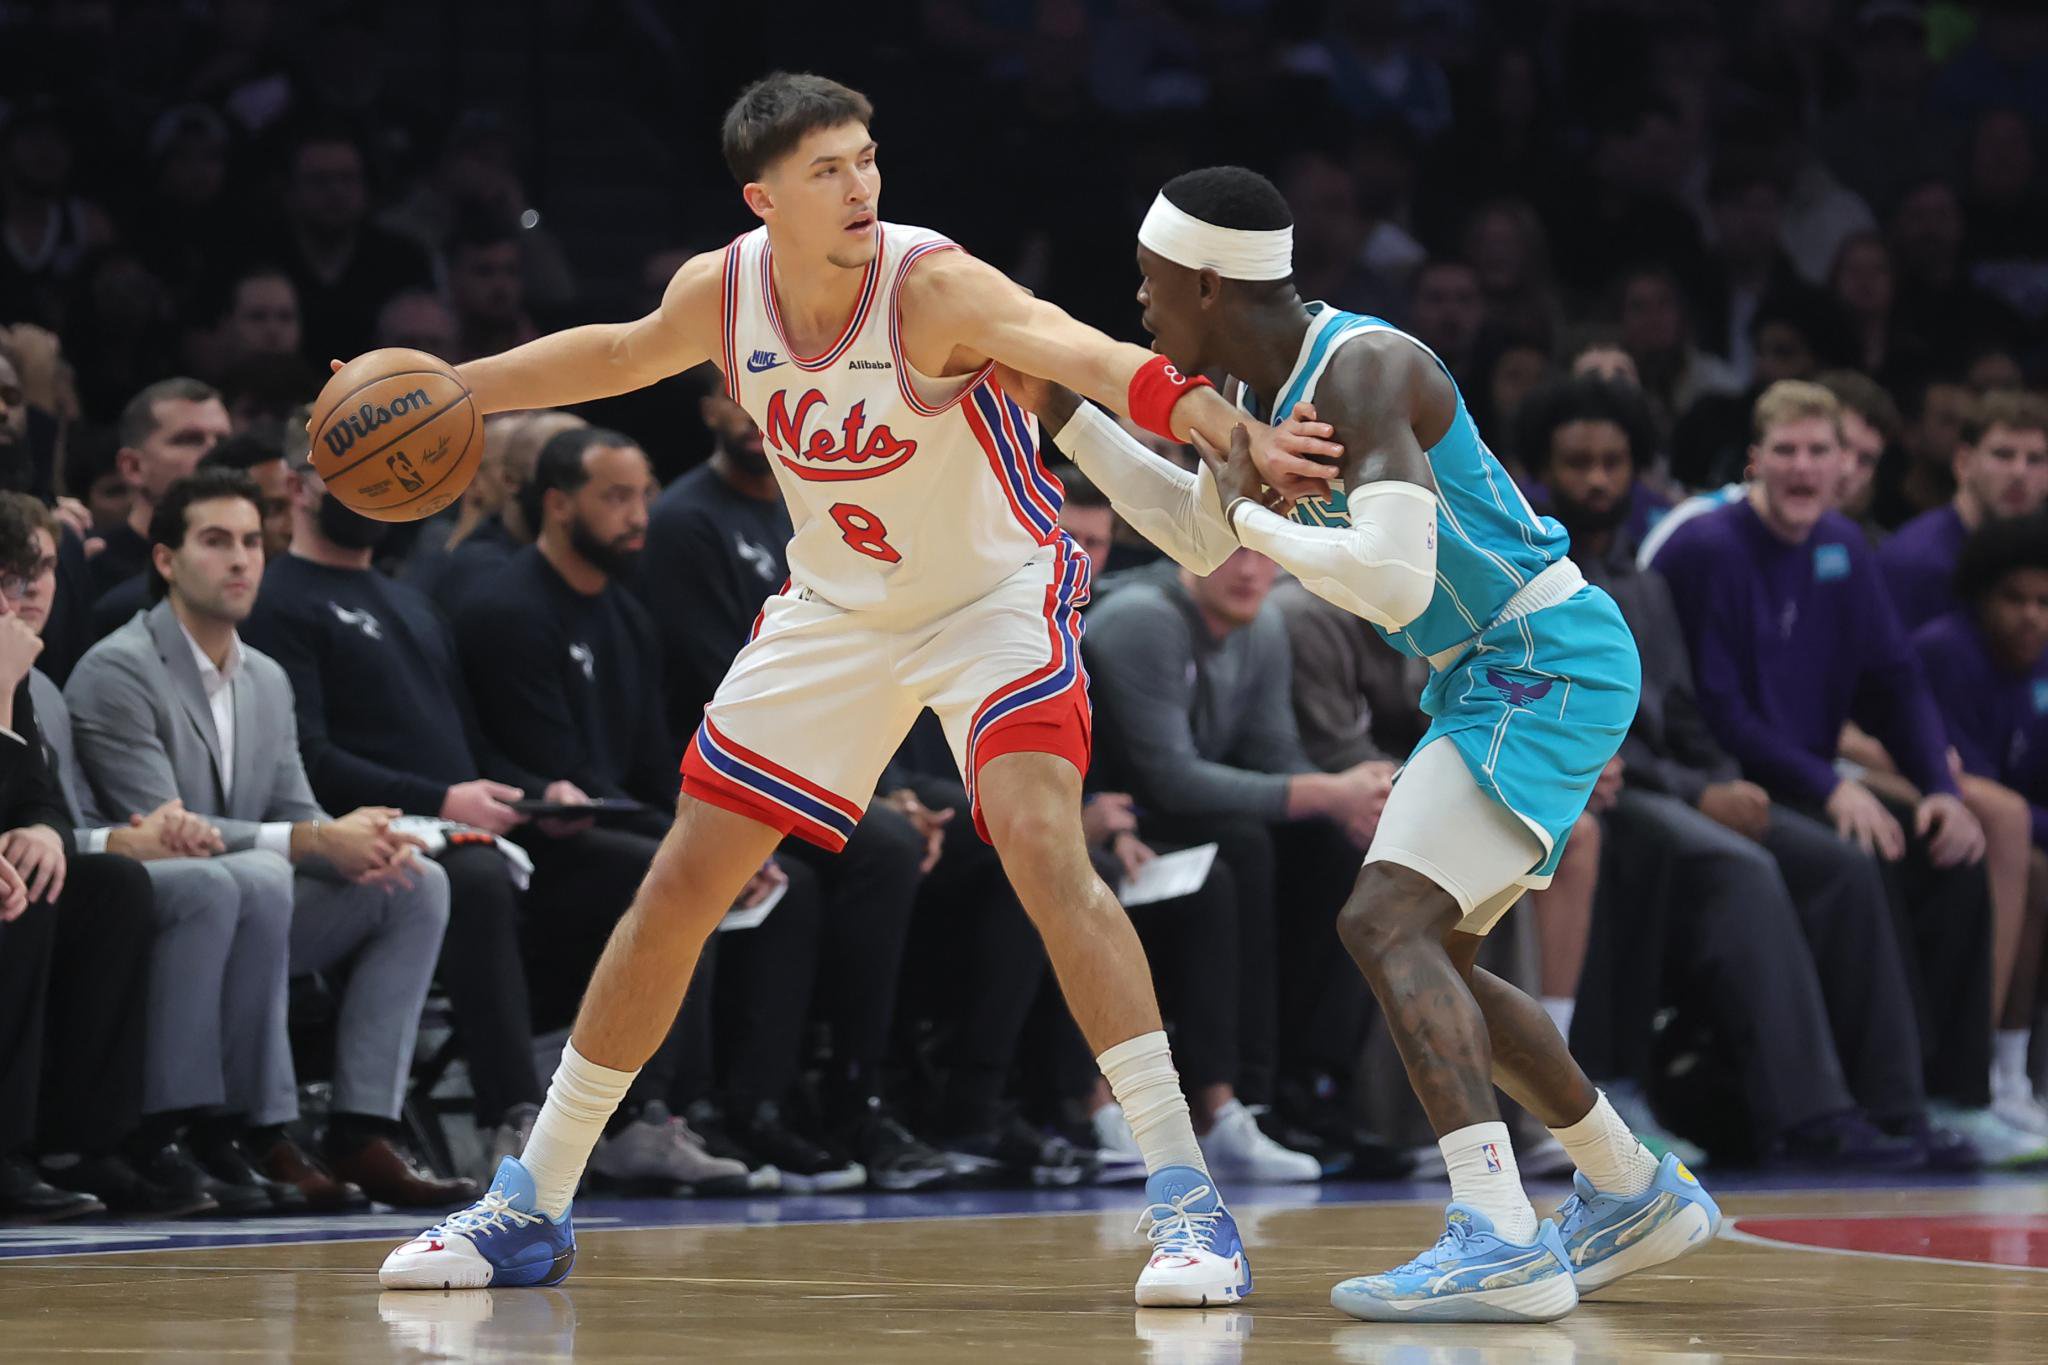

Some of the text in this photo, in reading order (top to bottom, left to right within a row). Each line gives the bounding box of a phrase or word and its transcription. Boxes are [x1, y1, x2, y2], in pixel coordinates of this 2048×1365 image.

[751, 349, 777, 366] NIKE
[848, 360, 892, 370] Alibaba
[1163, 364, 1186, 385] 8
[323, 388, 432, 457] Wilson
[766, 388, 918, 482] Nets
[828, 502, 902, 564] 8
